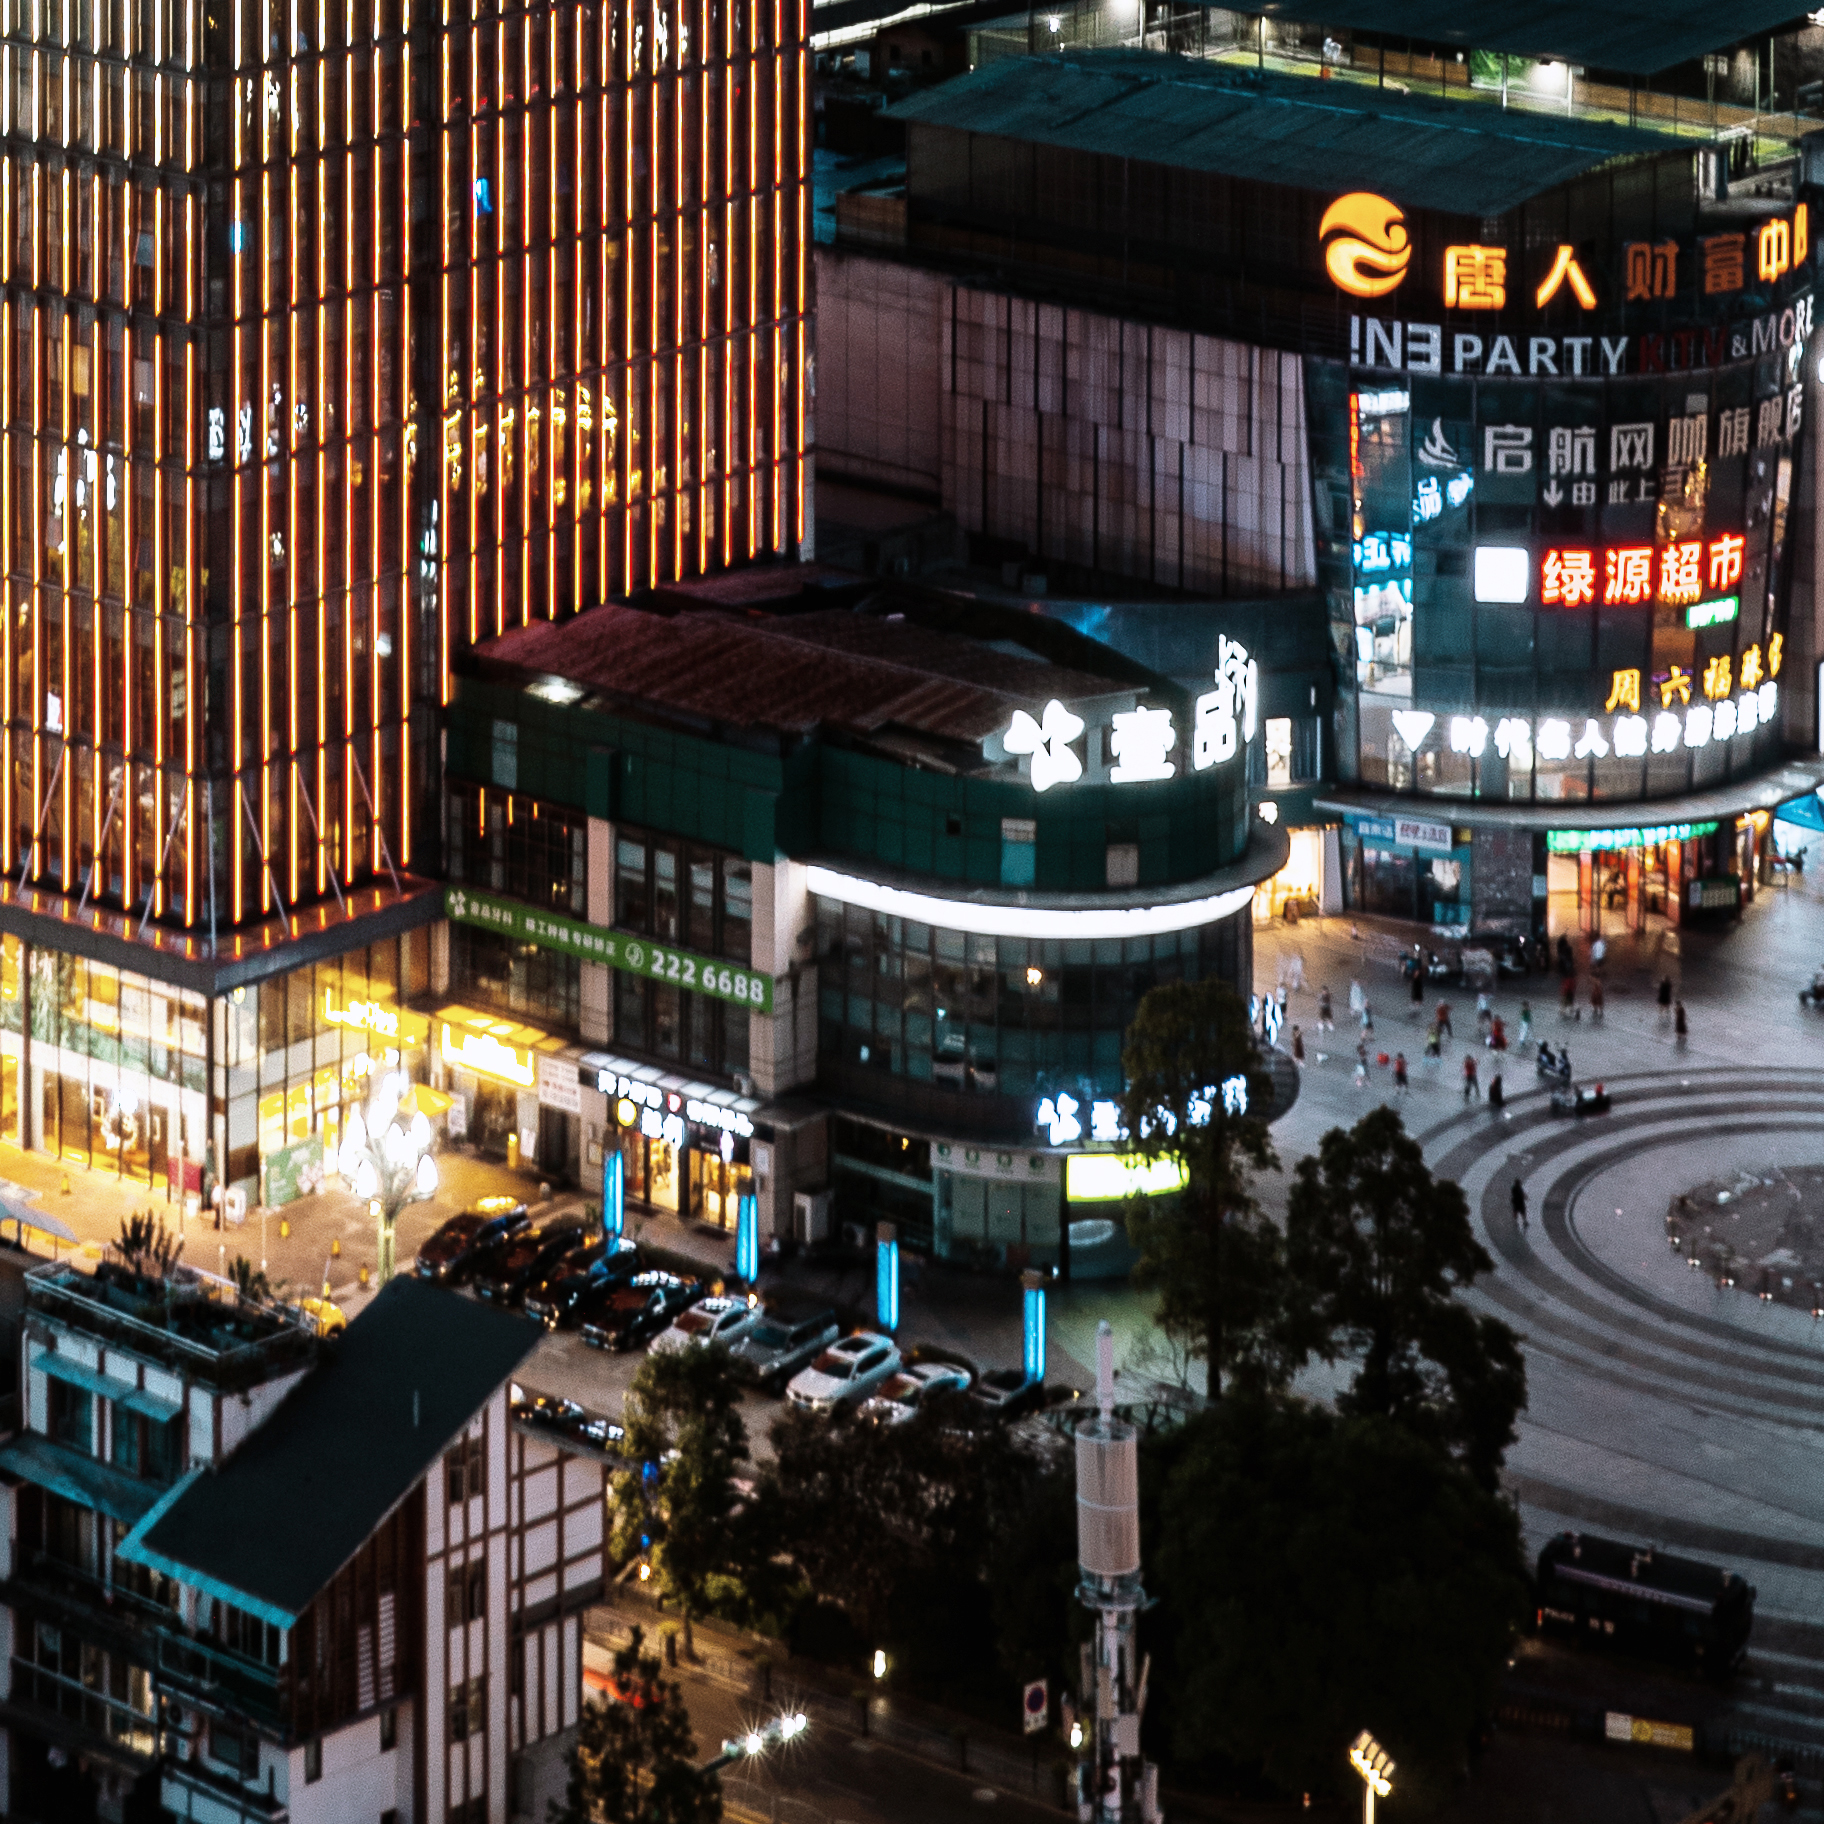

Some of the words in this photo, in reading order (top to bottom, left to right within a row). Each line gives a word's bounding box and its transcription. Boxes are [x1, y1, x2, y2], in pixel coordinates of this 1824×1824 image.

[1454, 334, 1629, 376] PARTY
[1639, 327, 1729, 373] KTV
[1540, 533, 1746, 607] 绿源超市
[650, 948, 698, 986] 222
[701, 965, 765, 1005] 6688
